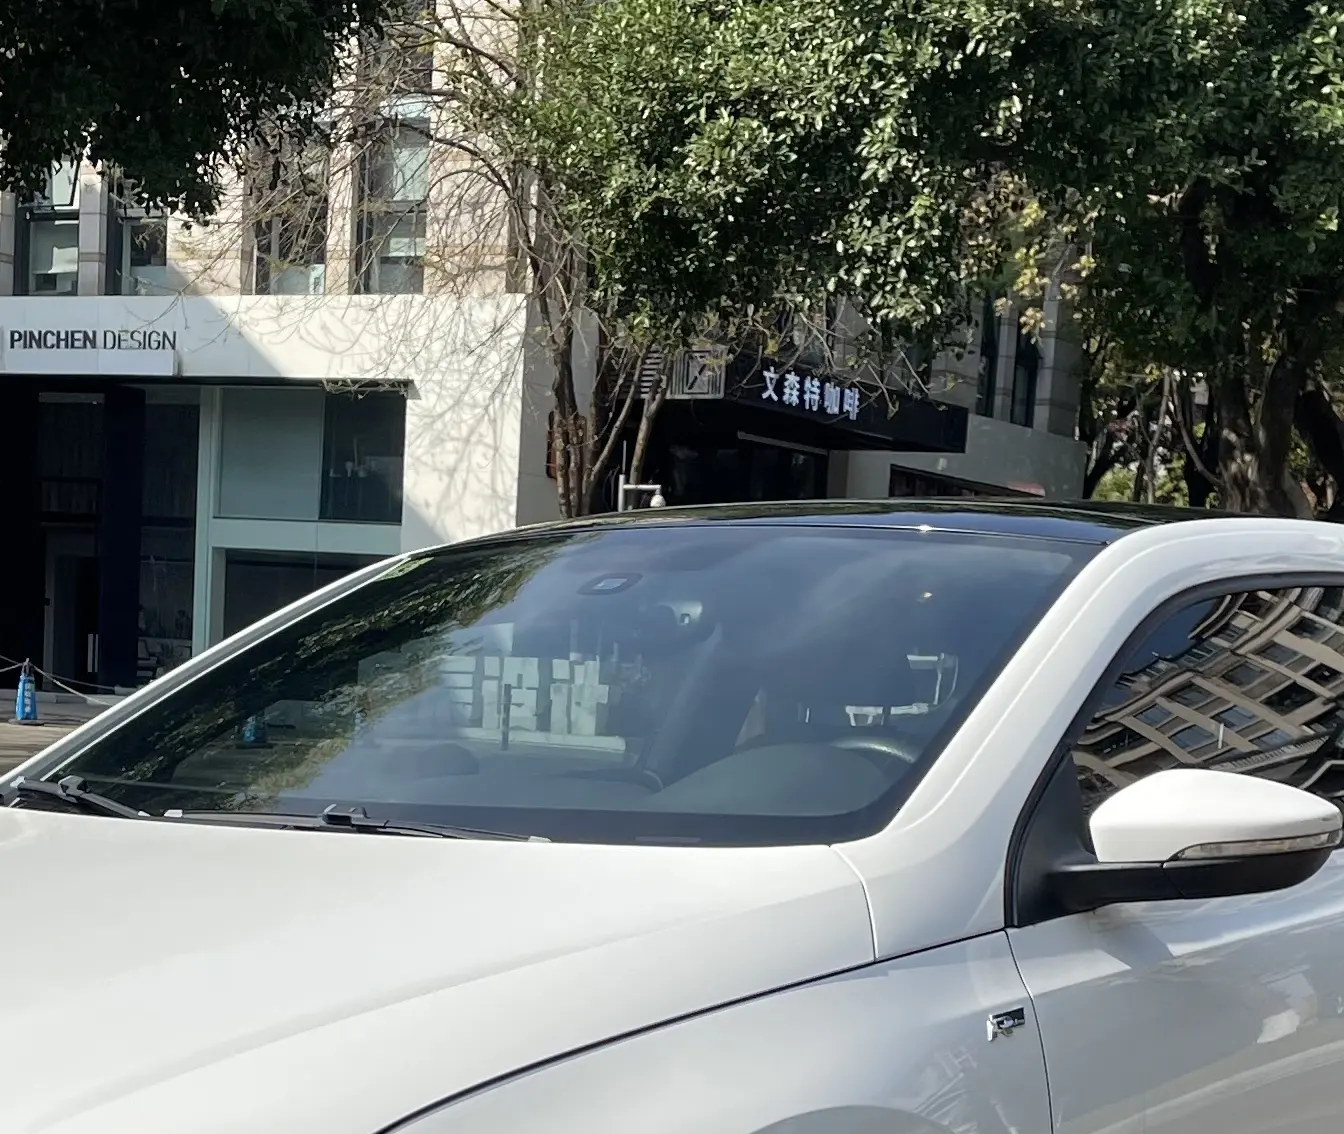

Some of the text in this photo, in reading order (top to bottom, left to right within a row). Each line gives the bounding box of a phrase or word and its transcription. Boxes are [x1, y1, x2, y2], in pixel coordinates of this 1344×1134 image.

[9, 330, 177, 350] PINCHEN DESIGN
[761, 365, 861, 420] 文森特咖啡
